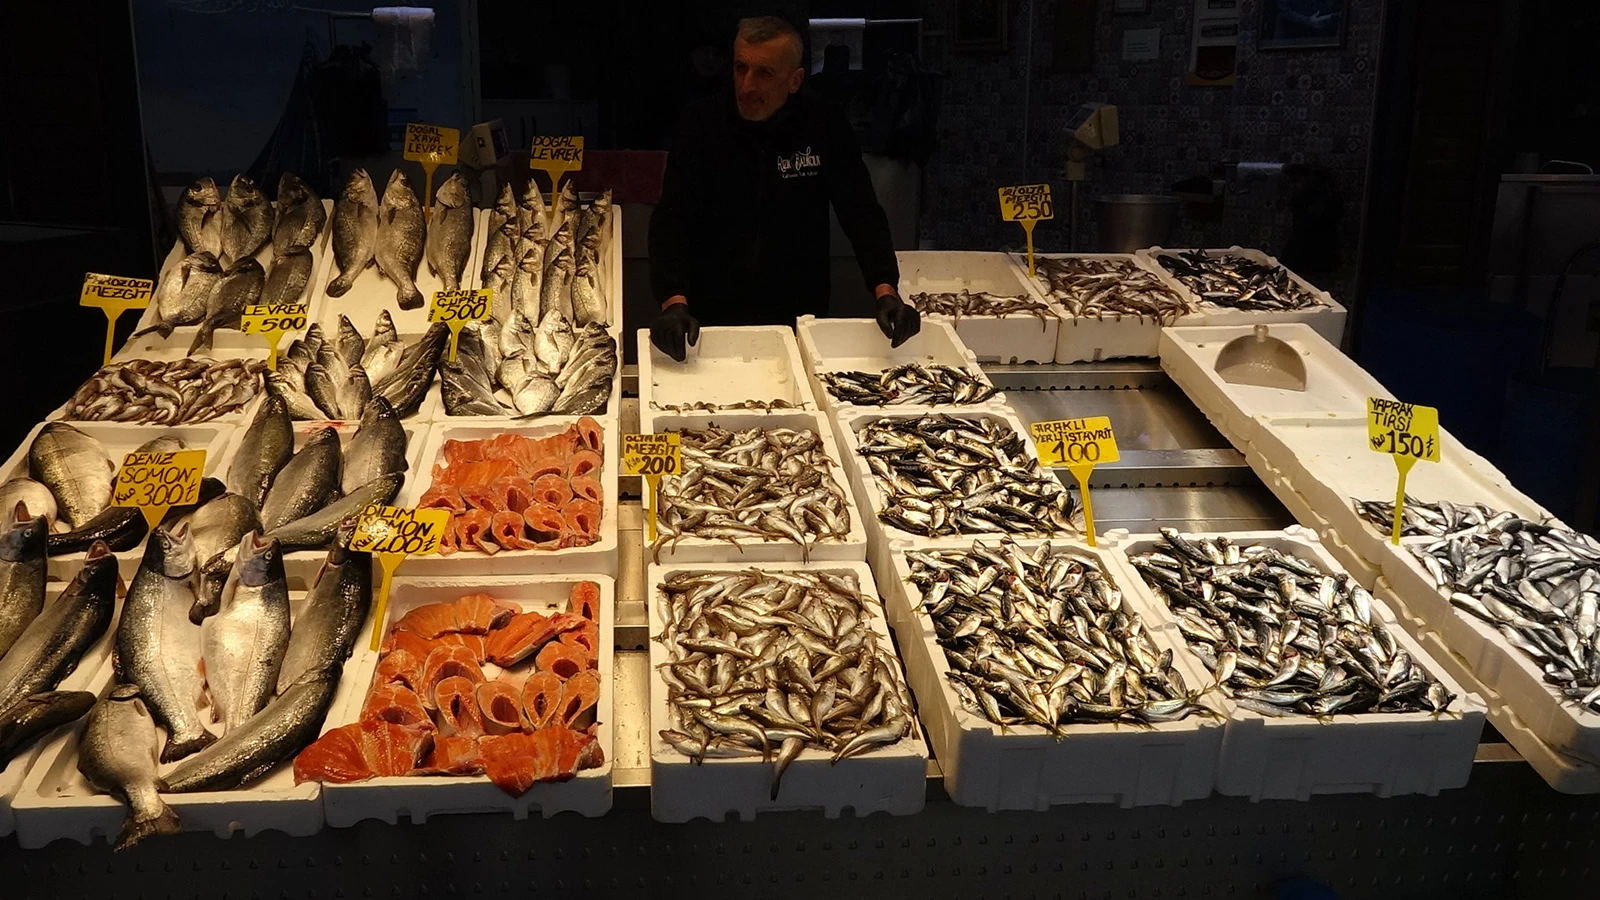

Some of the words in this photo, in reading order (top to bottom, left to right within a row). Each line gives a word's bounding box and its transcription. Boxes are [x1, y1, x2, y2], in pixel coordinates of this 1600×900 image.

[408, 143, 454, 156] LEVREK
[531, 147, 582, 161] LEVREK
[1013, 201, 1052, 219] 250
[242, 304, 307, 315] LEVREK
[440, 303, 486, 321] 500
[260, 317, 306, 332] 500
[1370, 397, 1413, 417] YAPRAK
[1035, 420, 1086, 433] ARAKLI
[1052, 441, 1100, 463] 100
[638, 455, 676, 474] 200
[120, 466, 197, 484] SOMON
